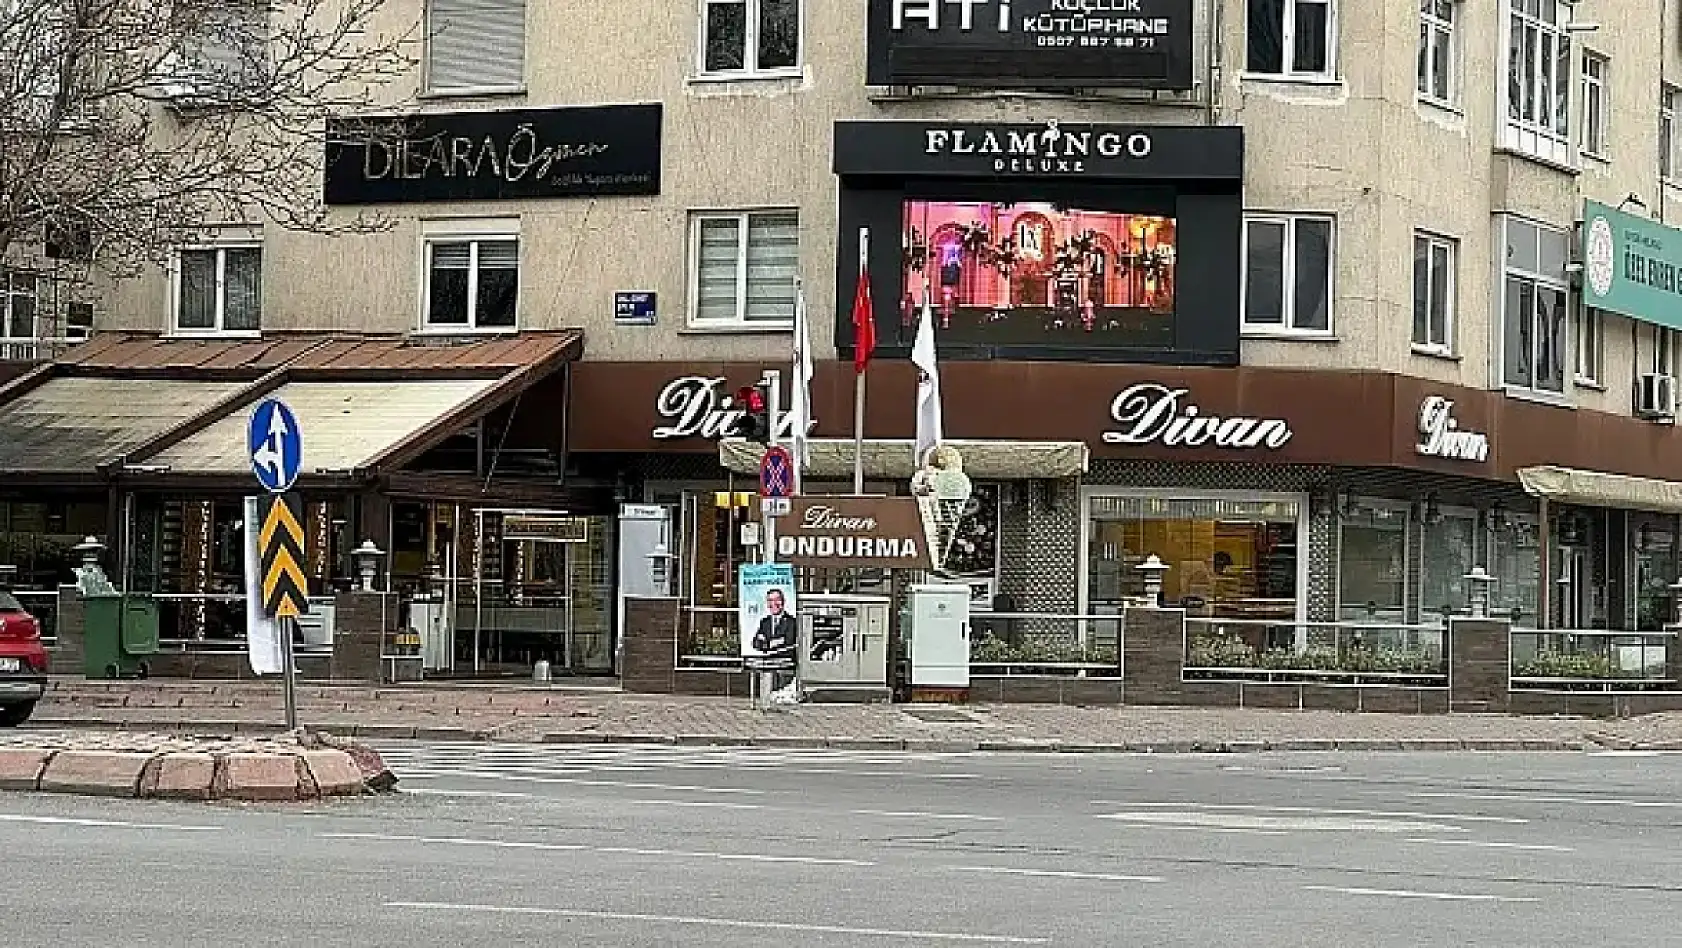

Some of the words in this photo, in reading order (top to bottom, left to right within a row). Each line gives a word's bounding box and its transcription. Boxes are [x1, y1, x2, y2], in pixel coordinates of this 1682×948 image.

[925, 119, 1151, 157] FLAMINGO
[994, 158, 1085, 172] DELUXE
[1102, 383, 1292, 449] Divan
[1416, 396, 1490, 462] Divan
[800, 505, 877, 530] Divan
[760, 536, 918, 558] ONDURMA
